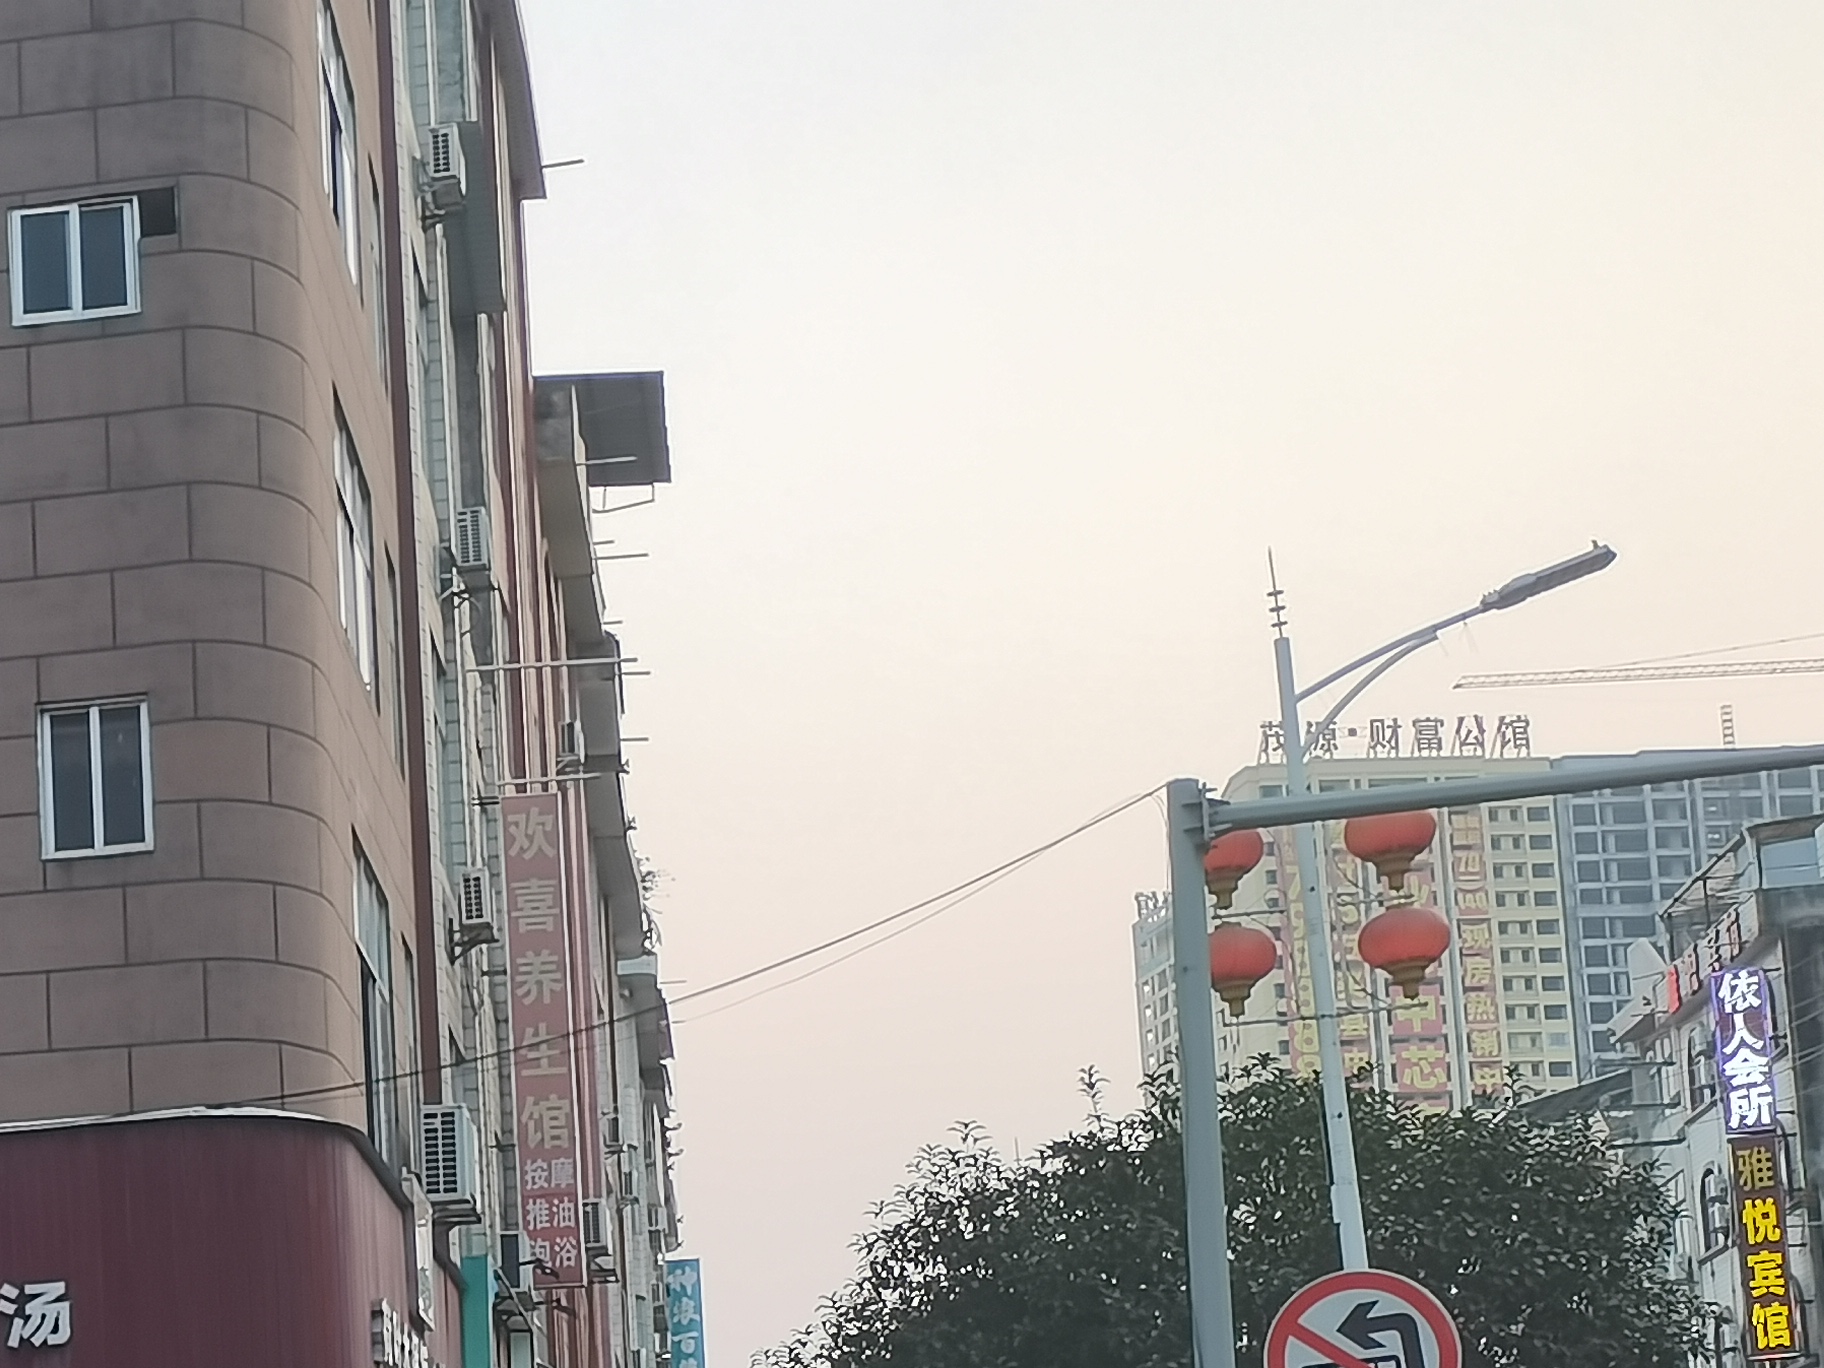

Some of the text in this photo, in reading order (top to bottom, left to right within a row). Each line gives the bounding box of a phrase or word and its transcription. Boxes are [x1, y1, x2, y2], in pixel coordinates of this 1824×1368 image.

[507, 807, 571, 1150] 欢喜养生馆
[1717, 970, 1774, 1130] 依人会所
[524, 1156, 575, 1190] 按摩
[526, 1197, 576, 1231] 推油
[1735, 1145, 1792, 1351] 雅悦宾馆
